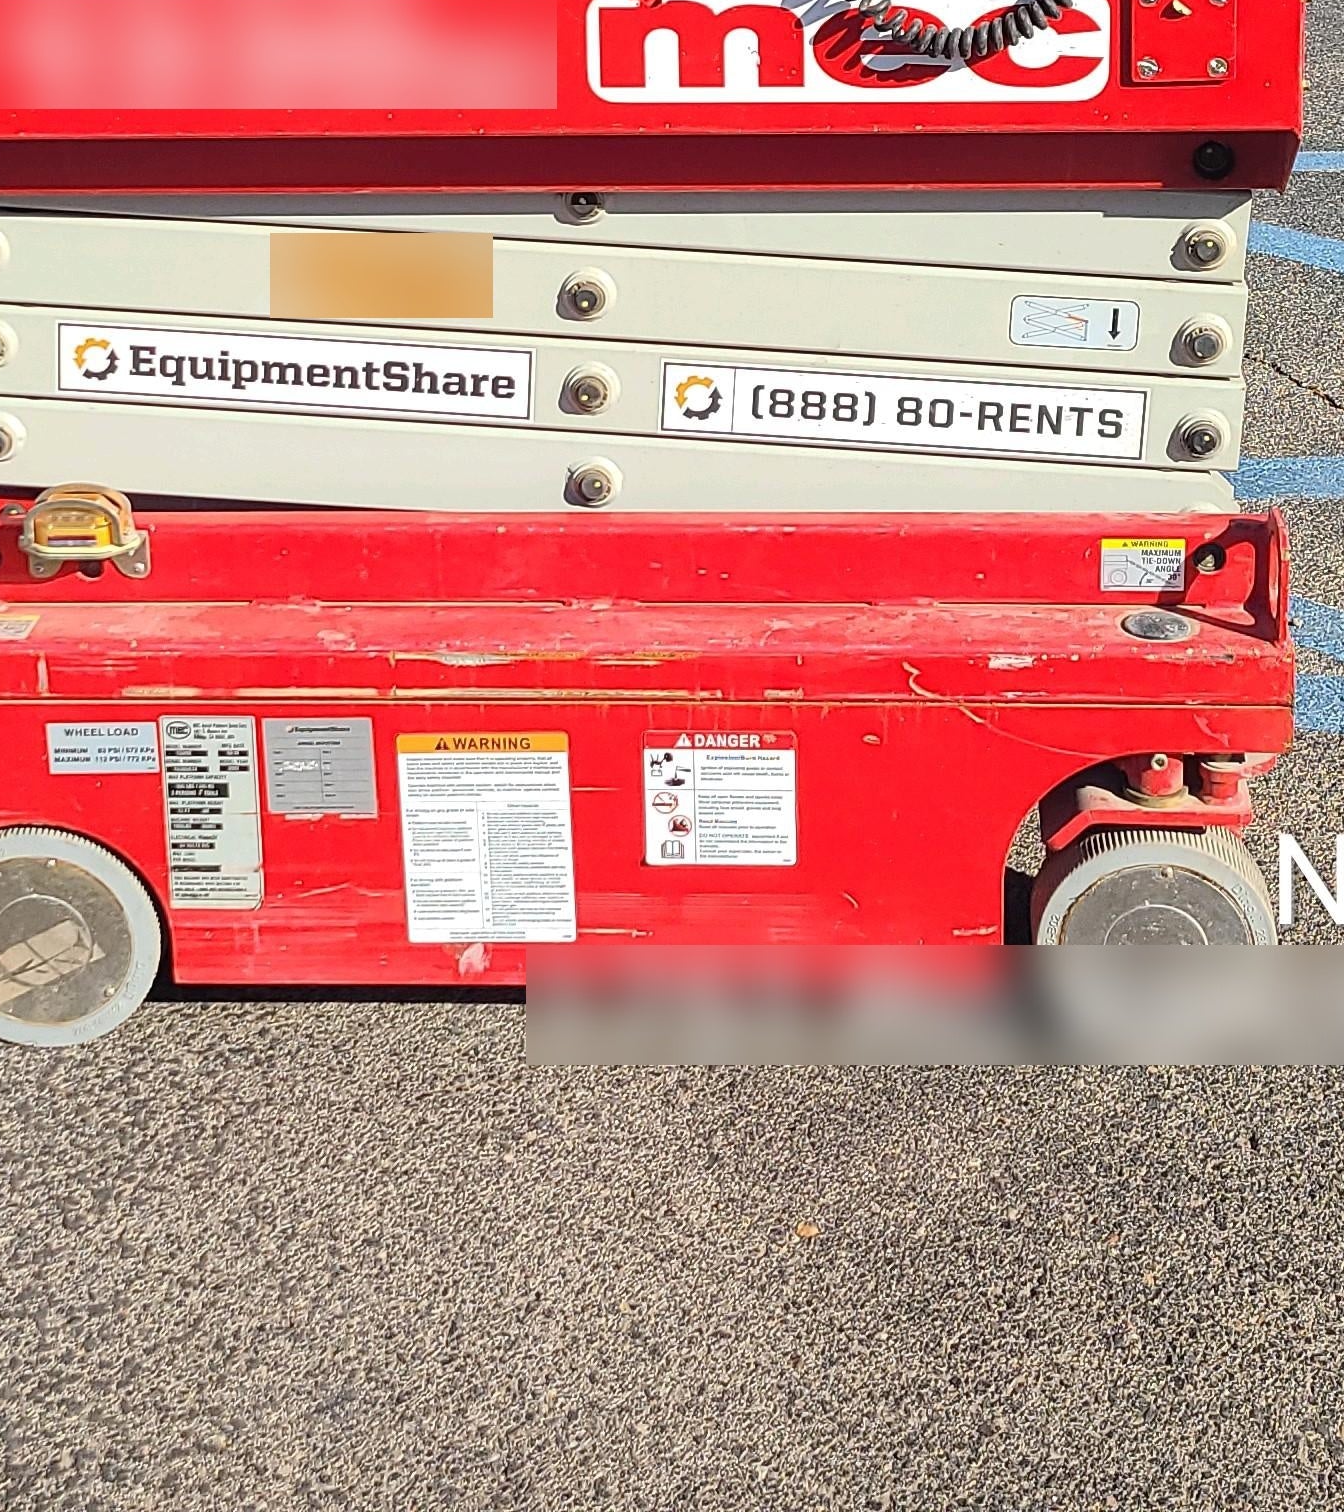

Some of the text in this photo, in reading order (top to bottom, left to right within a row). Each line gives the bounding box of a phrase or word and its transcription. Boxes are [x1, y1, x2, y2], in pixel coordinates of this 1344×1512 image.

[129, 345, 516, 399] EquipmentShare
[751, 384, 1124, 439] (888) 80-RENTS
[64, 728, 138, 737] WHEEL LOAD
[453, 737, 531, 750] WARNING
[694, 733, 761, 748] DANGER
